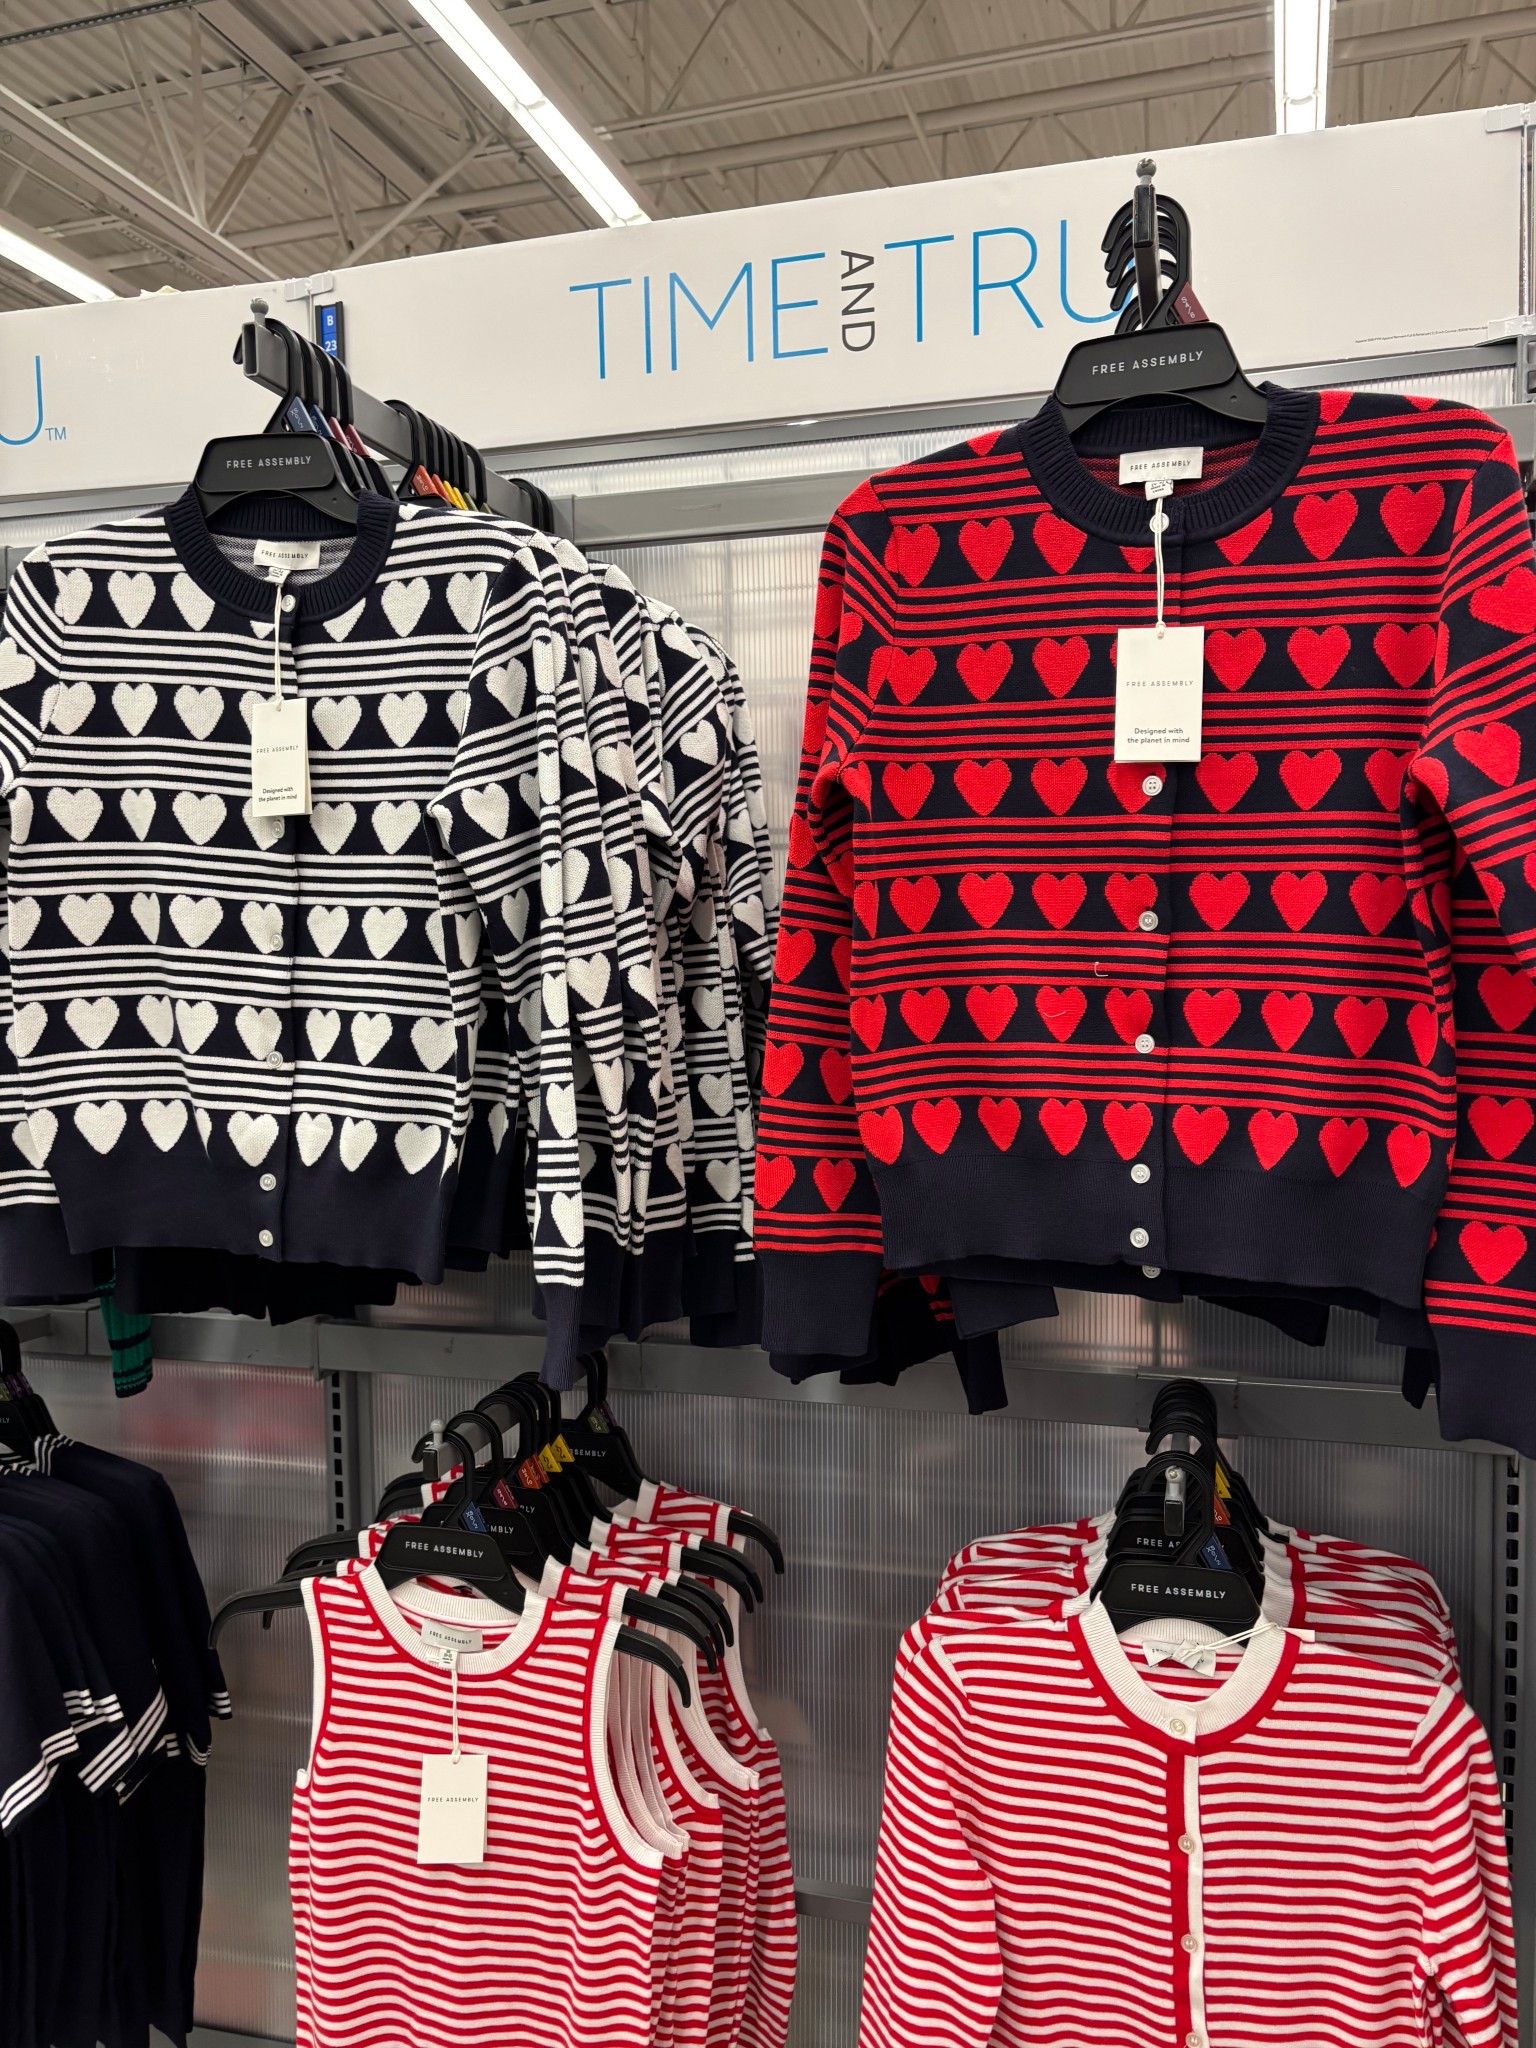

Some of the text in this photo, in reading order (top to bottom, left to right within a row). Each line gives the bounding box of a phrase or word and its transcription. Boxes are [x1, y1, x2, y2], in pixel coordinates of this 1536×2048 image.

[569, 219, 1135, 380] TIME AND TRU
[326, 315, 334, 327] B
[325, 339, 337, 352] 23
[1092, 350, 1204, 376] FREE ASSEMBLY
[226, 455, 312, 470] FREE ASSEMBLY
[1129, 459, 1192, 472] FREE ASSEMBLY
[261, 549, 309, 560] FREE ASSEMBLY
[1134, 727, 1167, 736] Designed
[1140, 737, 1162, 745] planet
[272, 744, 299, 753] ASSEMBLY
[262, 786, 283, 794] Designed
[487, 1525, 514, 1534] MBLY
[1136, 1537, 1163, 1548] FREE
[405, 1541, 484, 1559] FREE ASSEMBLY
[1131, 1583, 1226, 1599] FREE ASSEMBLY
[430, 1630, 473, 1645] FREE ASSEMBLY
